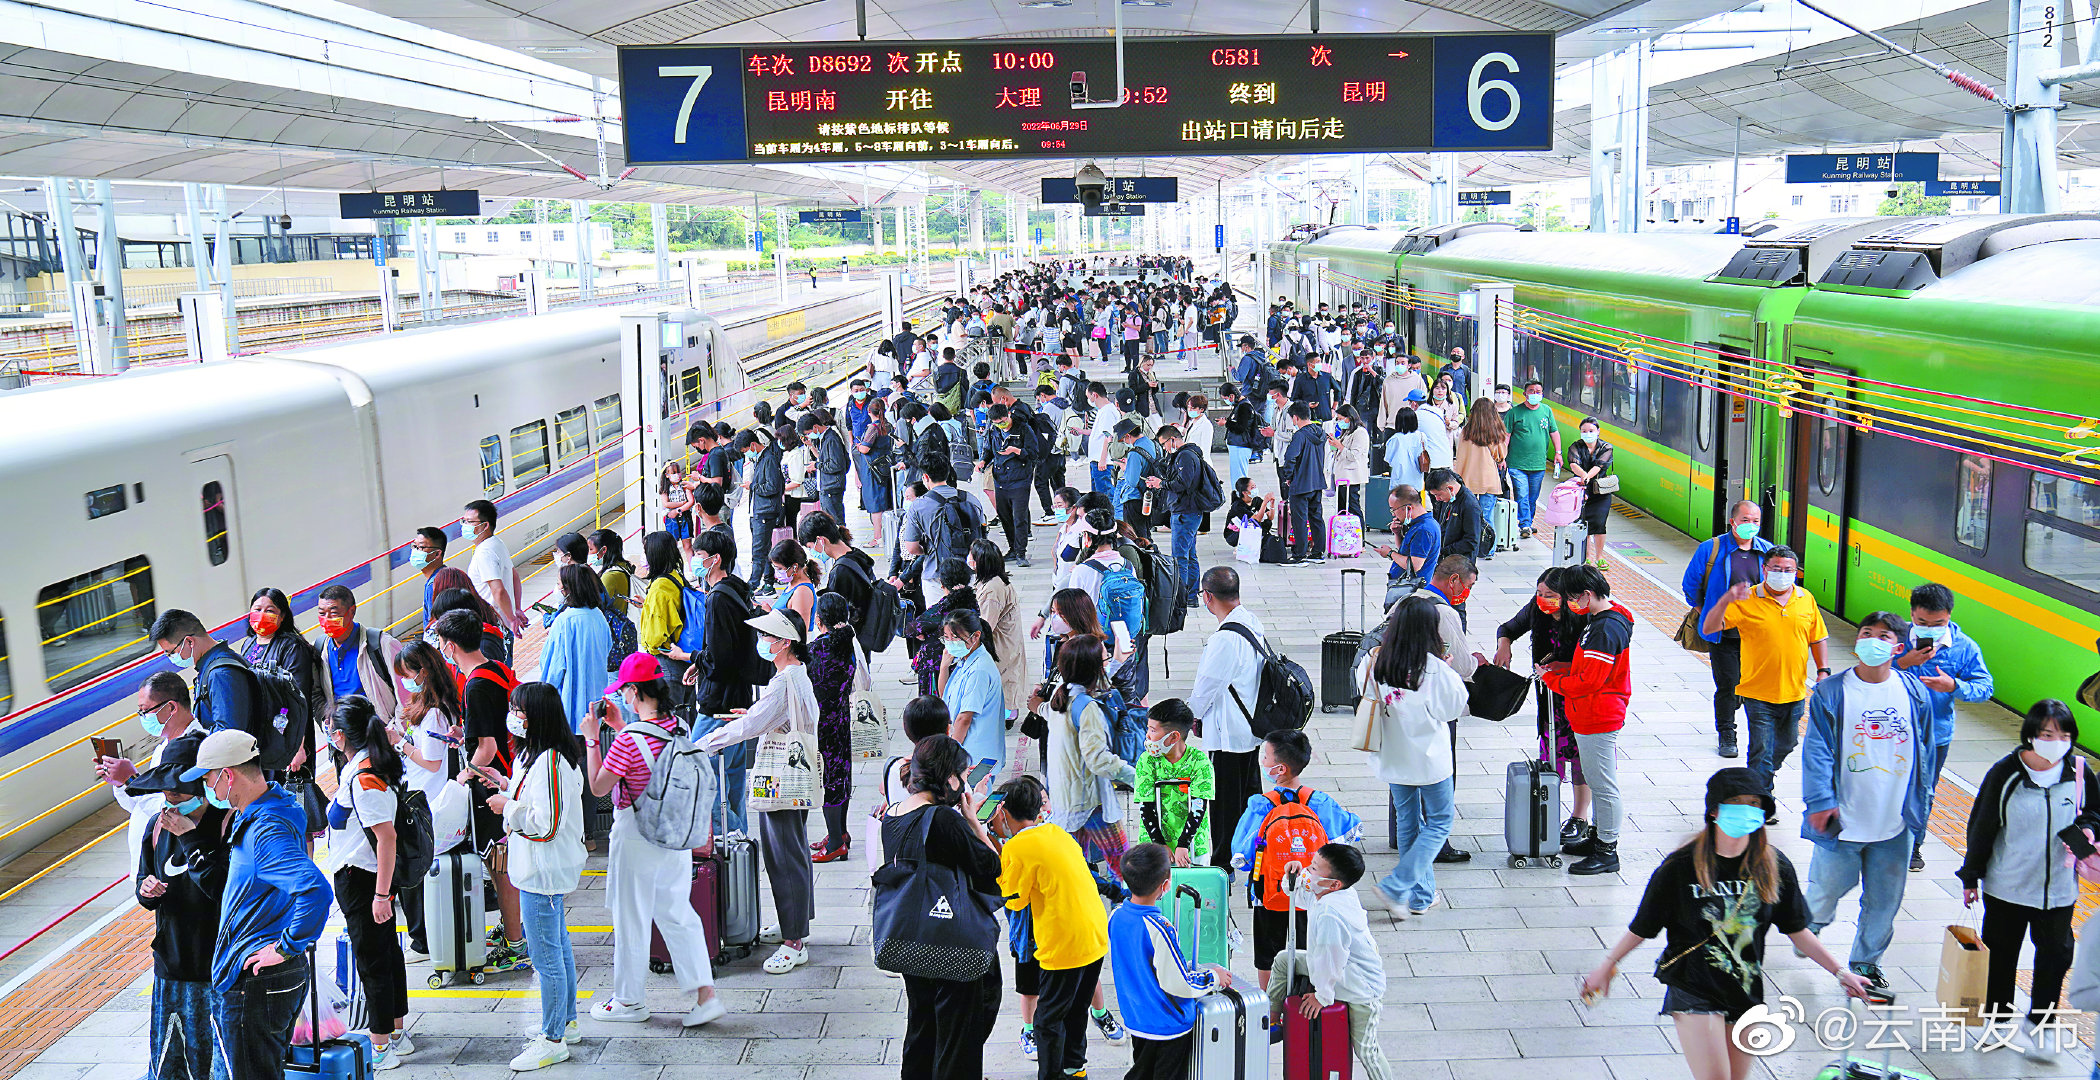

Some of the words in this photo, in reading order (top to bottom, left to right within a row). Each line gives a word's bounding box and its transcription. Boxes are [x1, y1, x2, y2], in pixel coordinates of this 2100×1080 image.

[2043, 6, 2055, 48] 812
[748, 54, 795, 76] 车次
[808, 54, 872, 74] D8692
[992, 52, 1054, 70] 10:00
[1211, 48, 1261, 67] C581
[1310, 45, 1333, 67] 次
[768, 89, 837, 113] 昆明南
[885, 89, 933, 112] 开往
[994, 86, 1042, 109] 大理
[1228, 82, 1276, 105] 终到
[1342, 80, 1386, 103] 昆明
[1467, 51, 1522, 132] 6
[657, 64, 714, 145] 7
[816, 120, 950, 137] 请按紫色地标排队等候
[1181, 117, 1345, 142] 出站口请向后走
[1040, 139, 1066, 149] 09:54
[1835, 156, 1891, 171] 昆明站
[1822, 172, 1852, 180] Kunming
[1853, 171, 1879, 180] Railway
[1880, 170, 1904, 179] Staon
[1104, 179, 1135, 192] 明站
[1950, 182, 1979, 190] 昆明站
[384, 194, 435, 208] 昆明站
[1103, 205, 1126, 213] 昆站
[373, 208, 400, 216] Kunming
[401, 207, 425, 215] Railway
